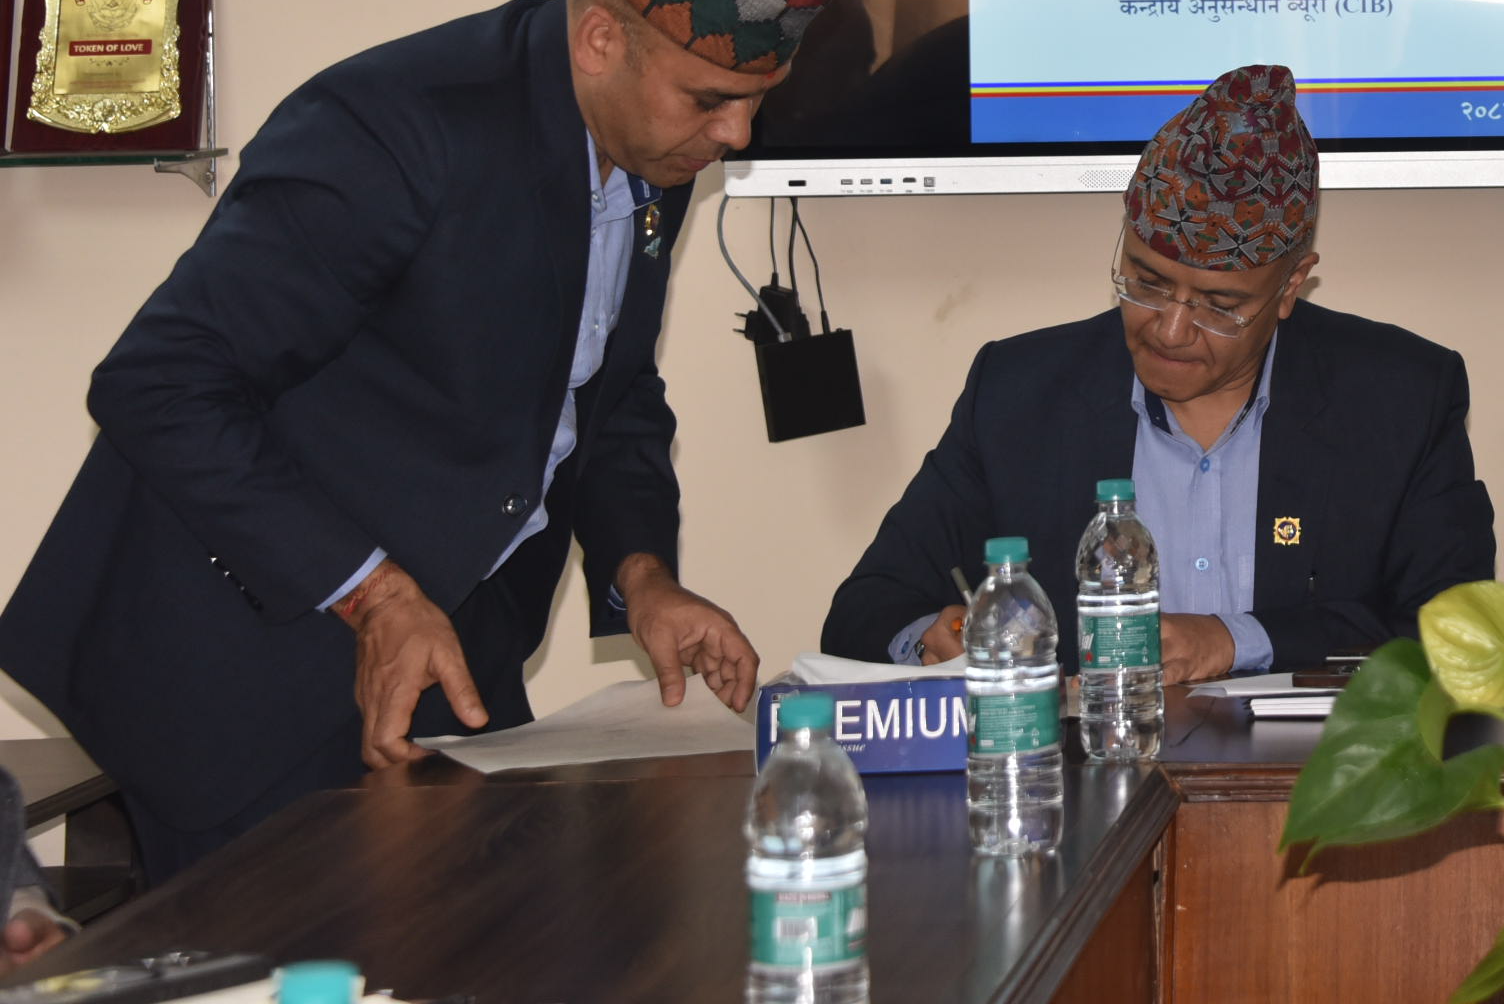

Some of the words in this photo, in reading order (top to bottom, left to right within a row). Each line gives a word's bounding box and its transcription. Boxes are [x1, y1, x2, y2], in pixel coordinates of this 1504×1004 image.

[73, 44, 104, 52] TOKEN
[106, 43, 118, 52] OF
[120, 43, 145, 52] LOVE
